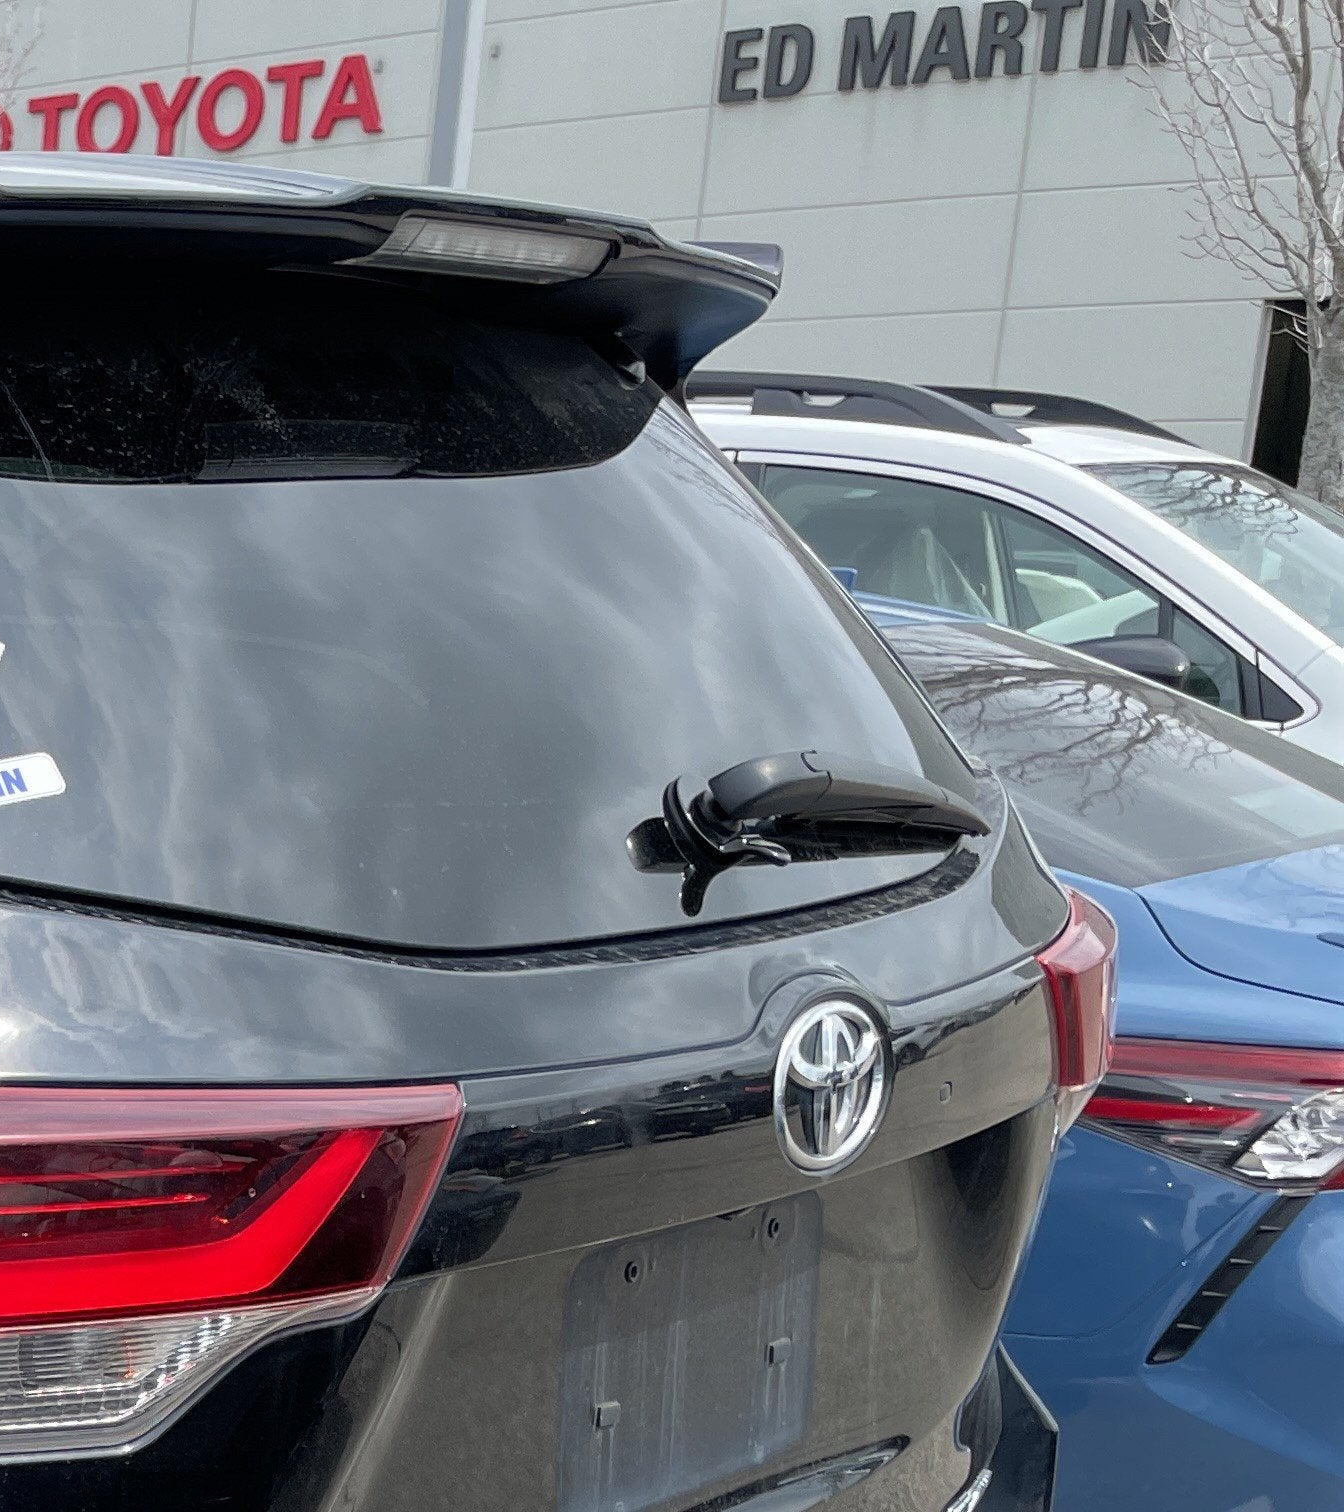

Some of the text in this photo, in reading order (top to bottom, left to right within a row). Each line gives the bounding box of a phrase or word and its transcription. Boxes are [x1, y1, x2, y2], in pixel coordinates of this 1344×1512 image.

[718, 0, 1173, 104] ED MARTIN
[27, 53, 383, 157] TOYOTA
